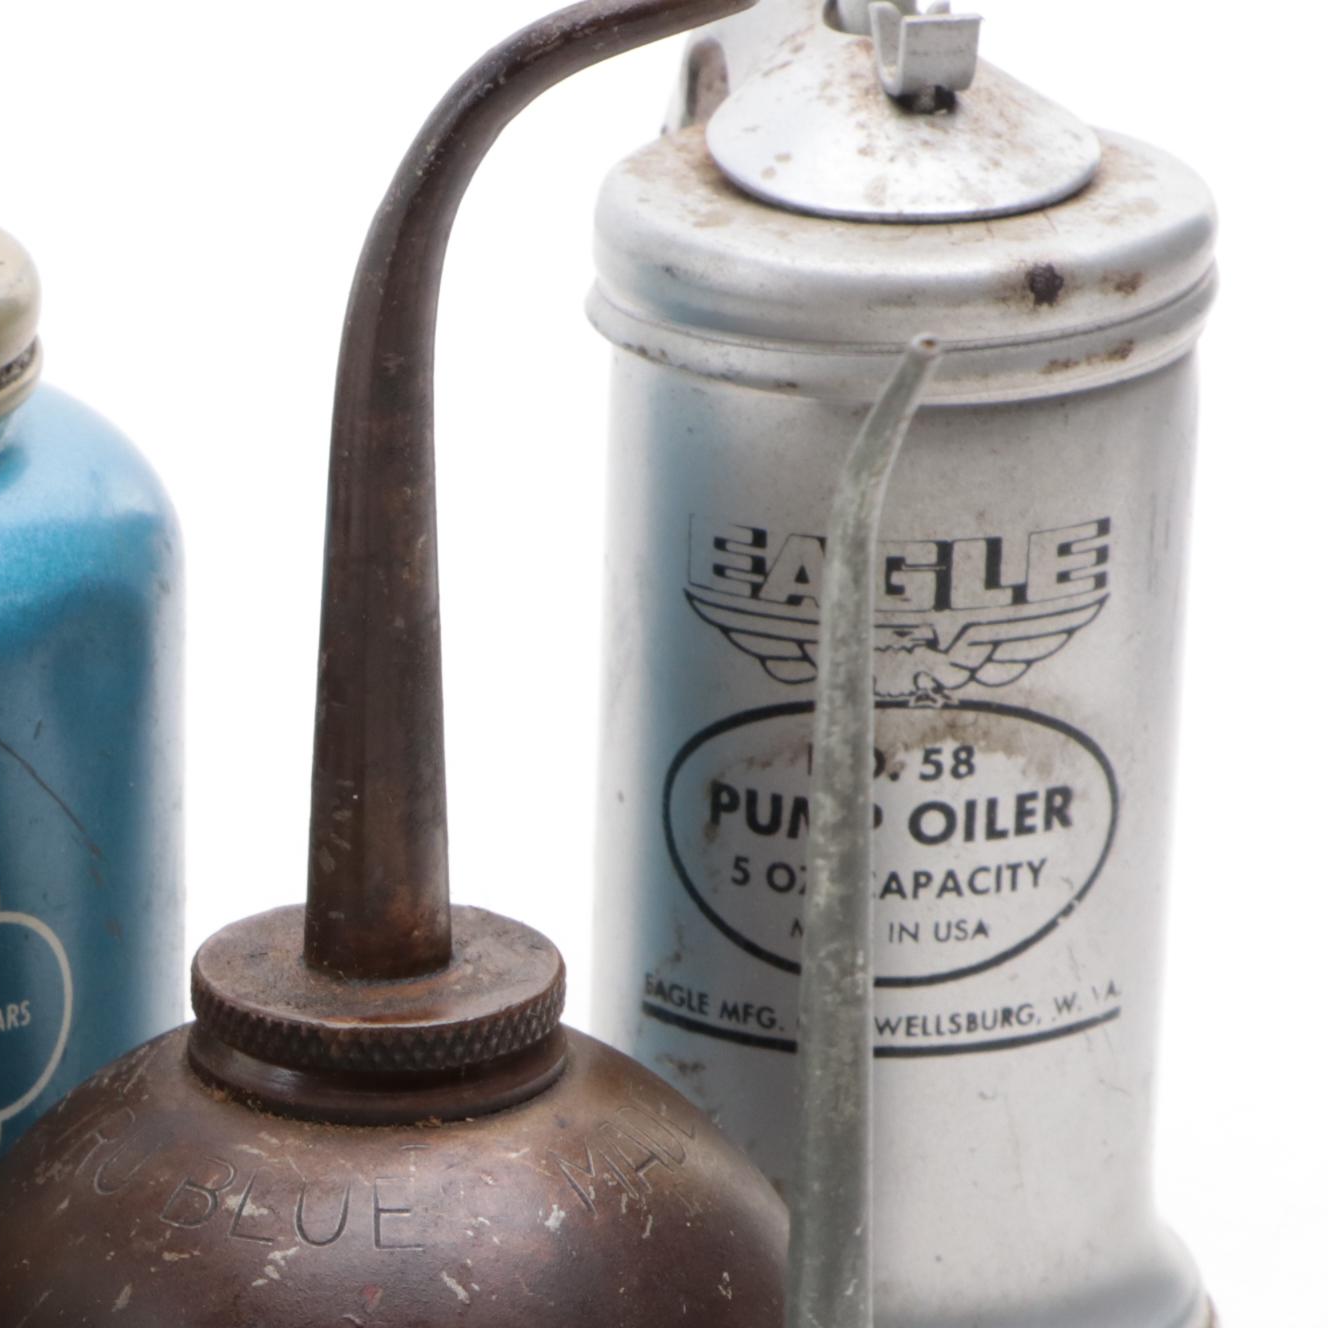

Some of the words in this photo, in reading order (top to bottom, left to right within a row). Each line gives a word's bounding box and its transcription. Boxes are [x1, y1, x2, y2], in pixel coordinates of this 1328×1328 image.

[689, 515, 1112, 613] EAGLE
[918, 744, 977, 782] 58
[907, 785, 1073, 846] OILER
[731, 855, 751, 887] 5
[873, 857, 1048, 900] APACITY
[888, 922, 920, 944] IN
[933, 918, 990, 944] USA
[644, 971, 710, 1017] EAGLE
[719, 1000, 785, 1032] MFG.
[158, 1156, 427, 1252] BLUE
